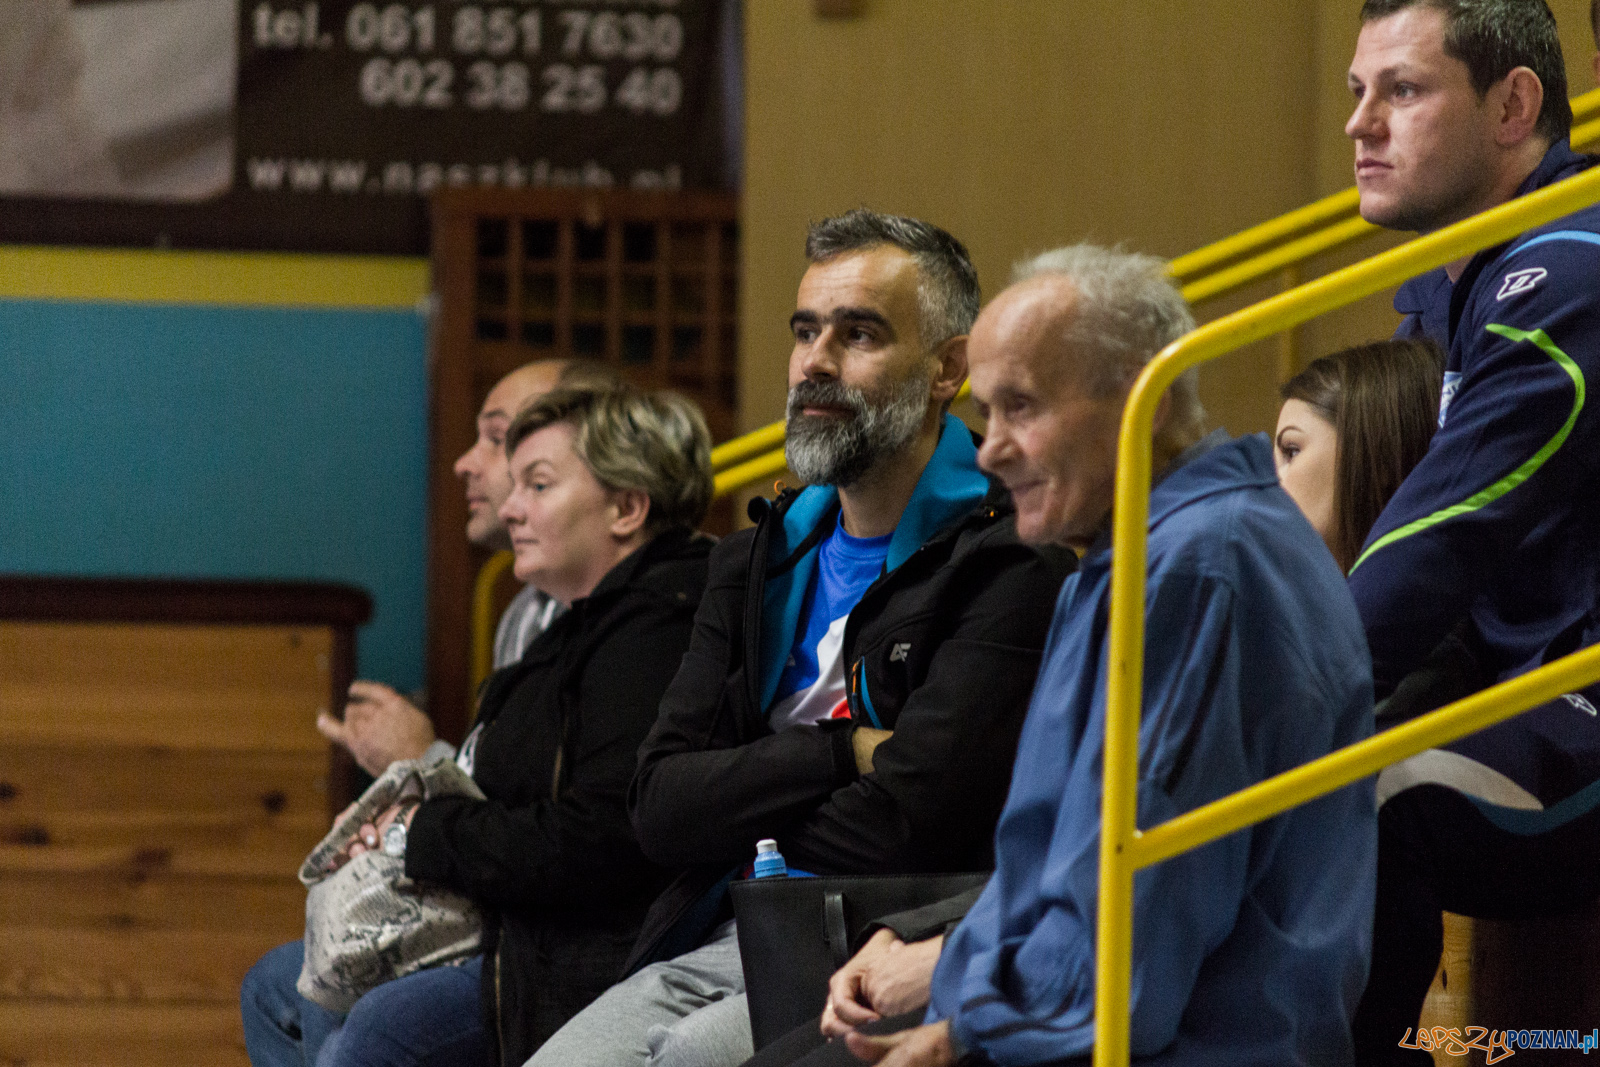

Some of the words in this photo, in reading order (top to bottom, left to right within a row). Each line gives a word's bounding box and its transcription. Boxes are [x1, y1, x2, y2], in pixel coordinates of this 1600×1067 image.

[252, 3, 334, 49] tel.
[346, 3, 437, 51] 061
[452, 6, 542, 55] 851
[557, 10, 683, 60] 7630
[360, 57, 455, 107] 602
[466, 60, 531, 110] 38
[540, 63, 607, 113] 25
[615, 67, 683, 115] 40
